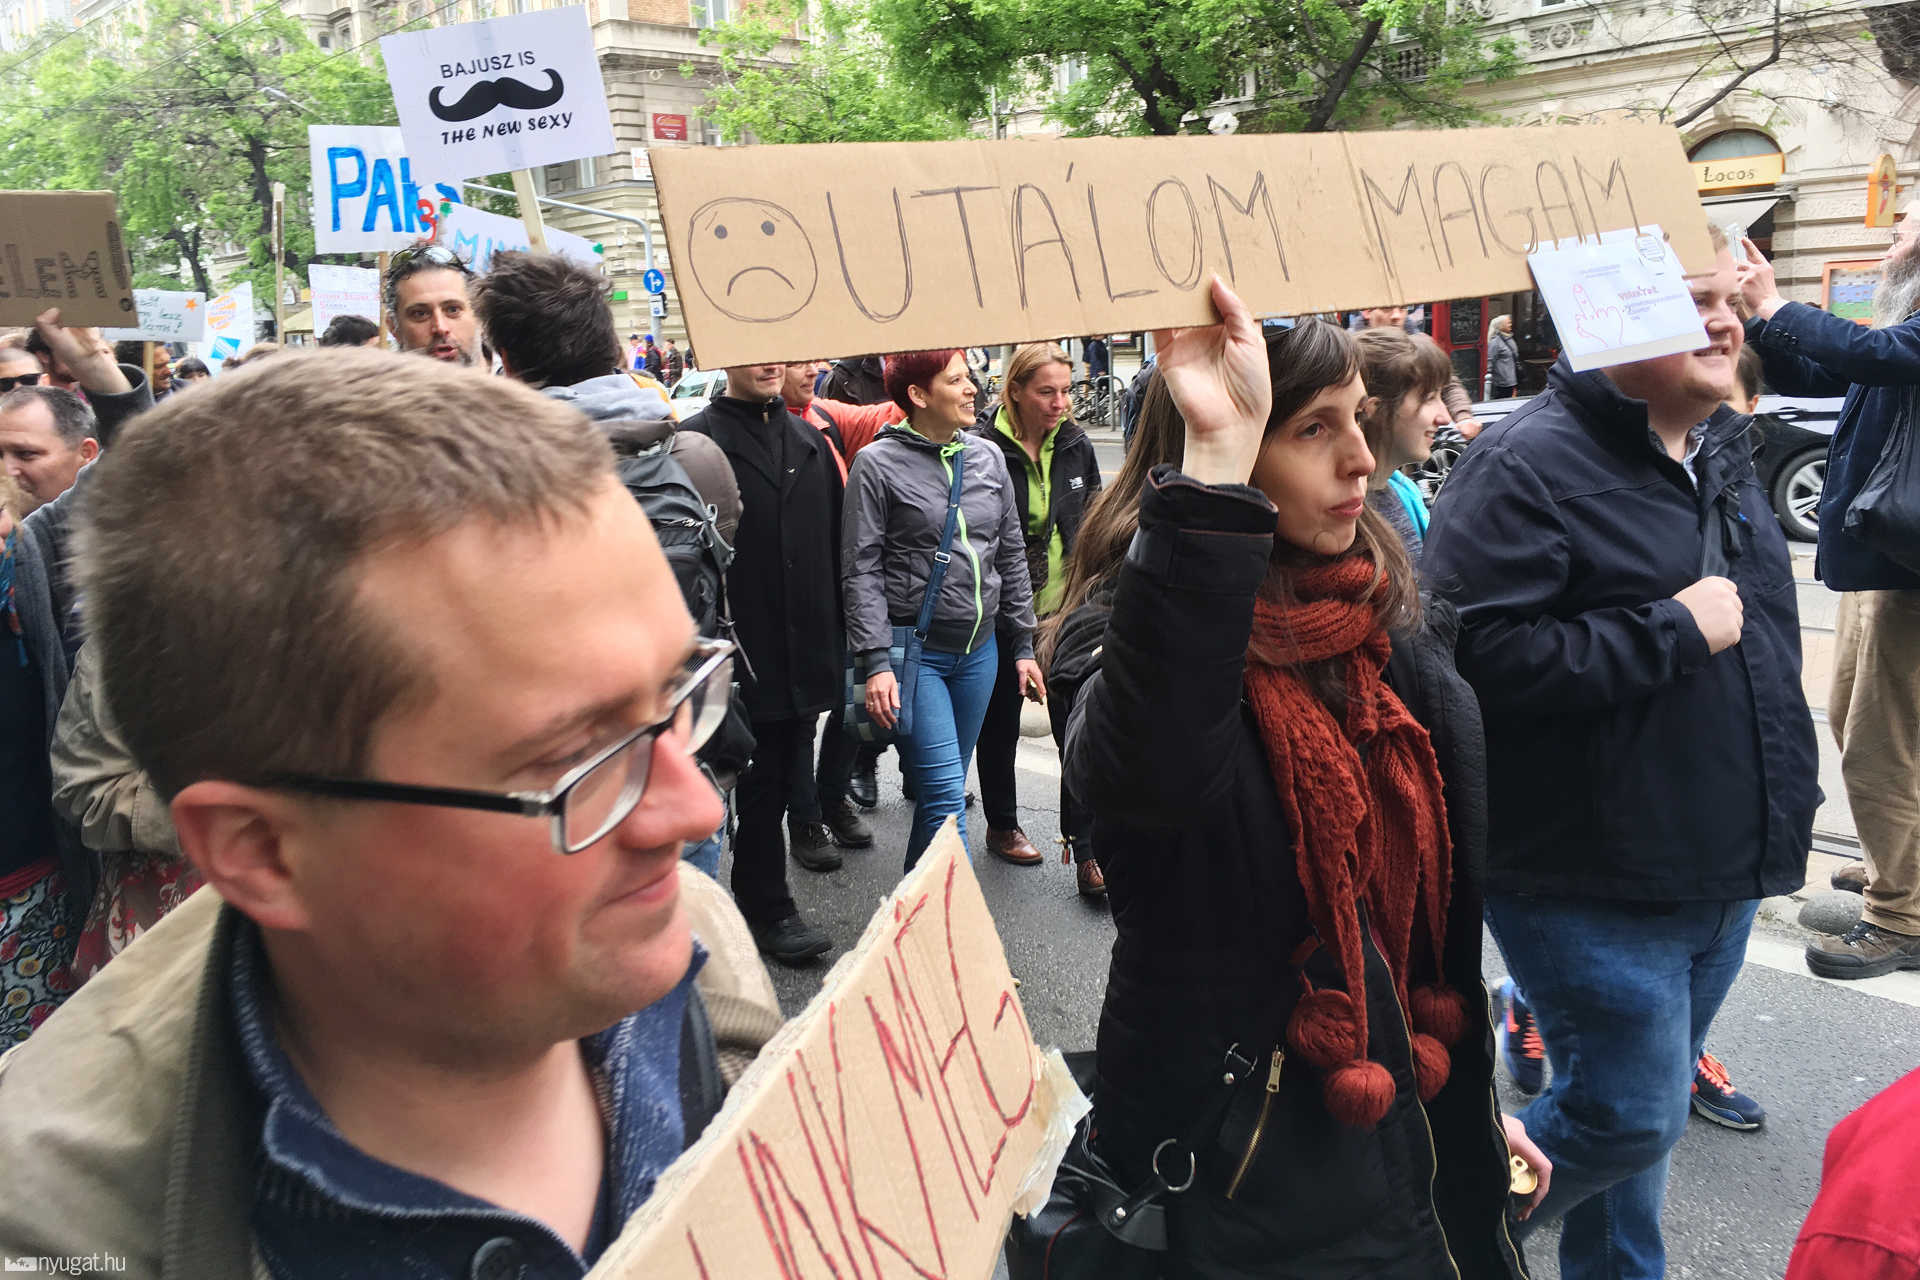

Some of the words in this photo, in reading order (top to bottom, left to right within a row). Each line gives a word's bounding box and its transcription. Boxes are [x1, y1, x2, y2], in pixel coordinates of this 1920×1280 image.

[440, 54, 514, 79] BAJUSZ
[518, 51, 536, 66] IS
[441, 127, 476, 145] THE
[482, 120, 522, 139] NEW
[528, 112, 573, 131] SEXY
[327, 147, 463, 233] PAK
[827, 162, 1290, 323] UTÁLOM
[1360, 155, 1641, 280] MAGAM
